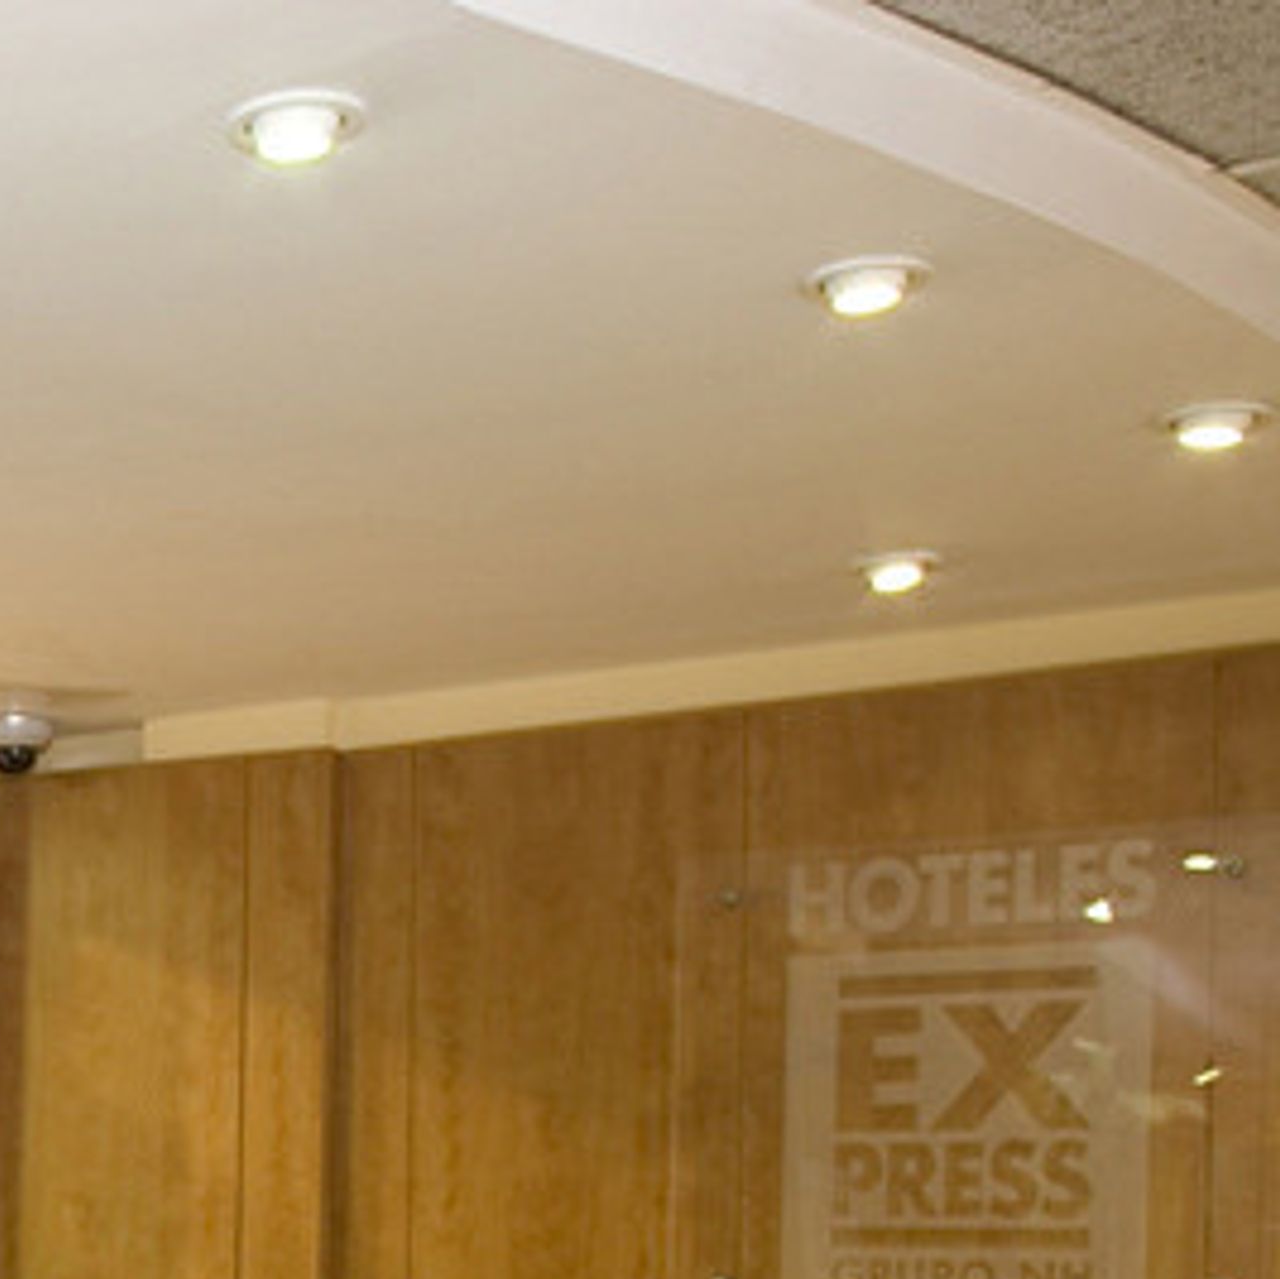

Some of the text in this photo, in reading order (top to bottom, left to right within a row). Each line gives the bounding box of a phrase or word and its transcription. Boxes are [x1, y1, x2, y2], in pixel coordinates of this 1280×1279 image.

[789, 840, 1156, 941] HOTELES
[836, 1001, 1091, 1133] EX
[834, 1138, 1092, 1217] PRESS
